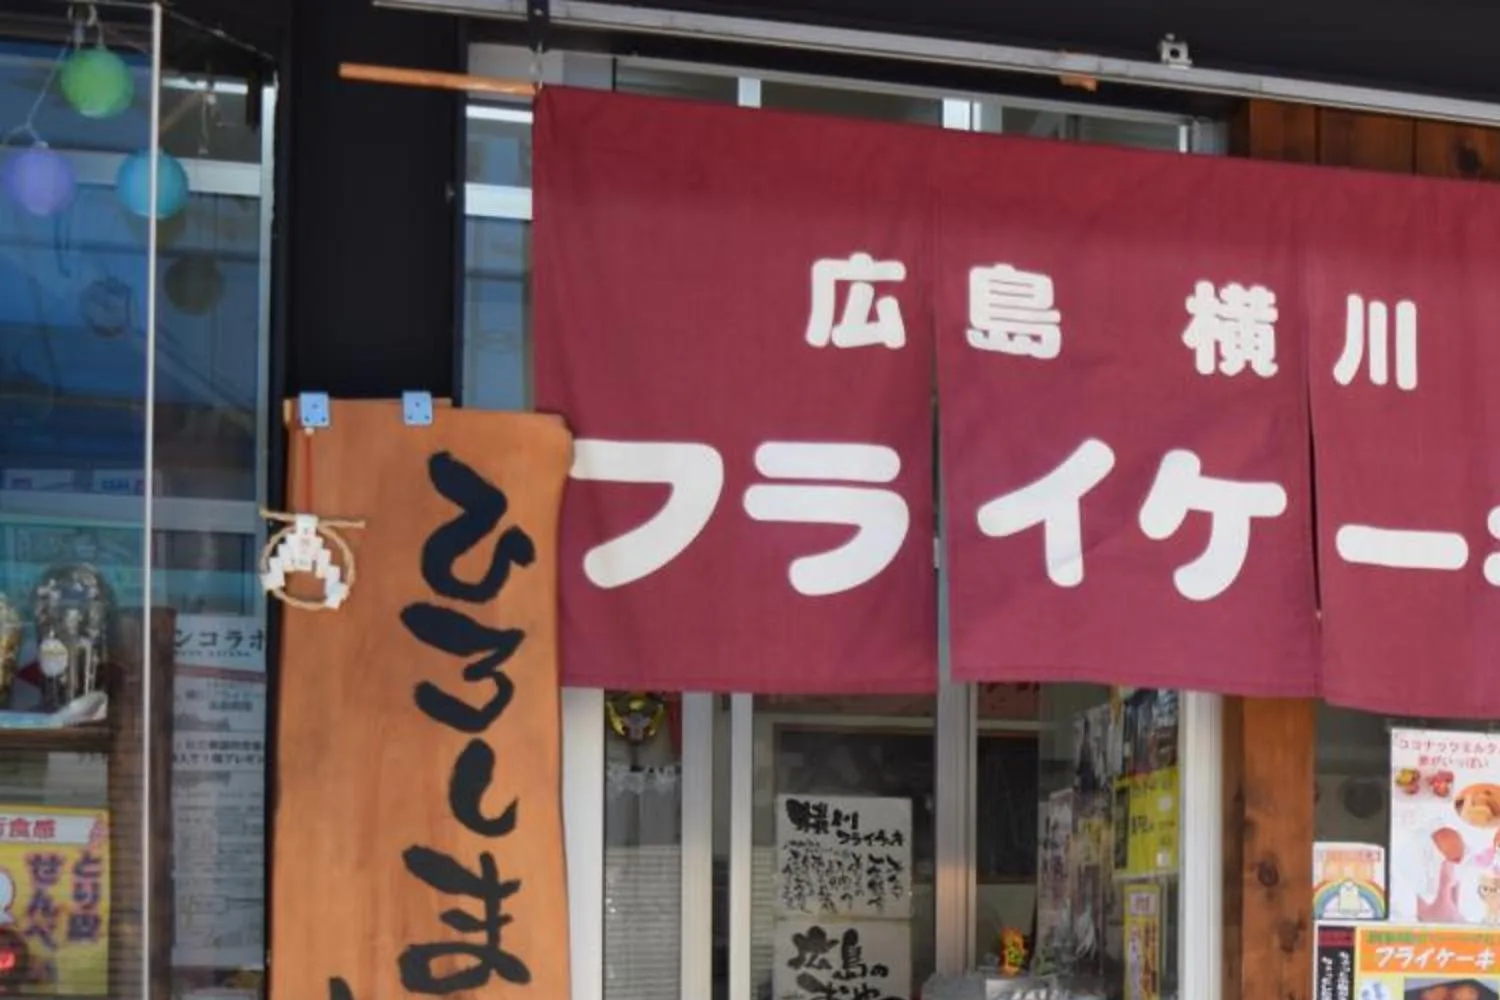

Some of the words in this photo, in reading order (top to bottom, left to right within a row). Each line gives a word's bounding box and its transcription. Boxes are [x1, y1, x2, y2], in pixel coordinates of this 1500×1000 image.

[806, 252, 1061, 358] 広島
[1182, 280, 1417, 390] 横川
[1376, 945, 1496, 970] フライケーキ
